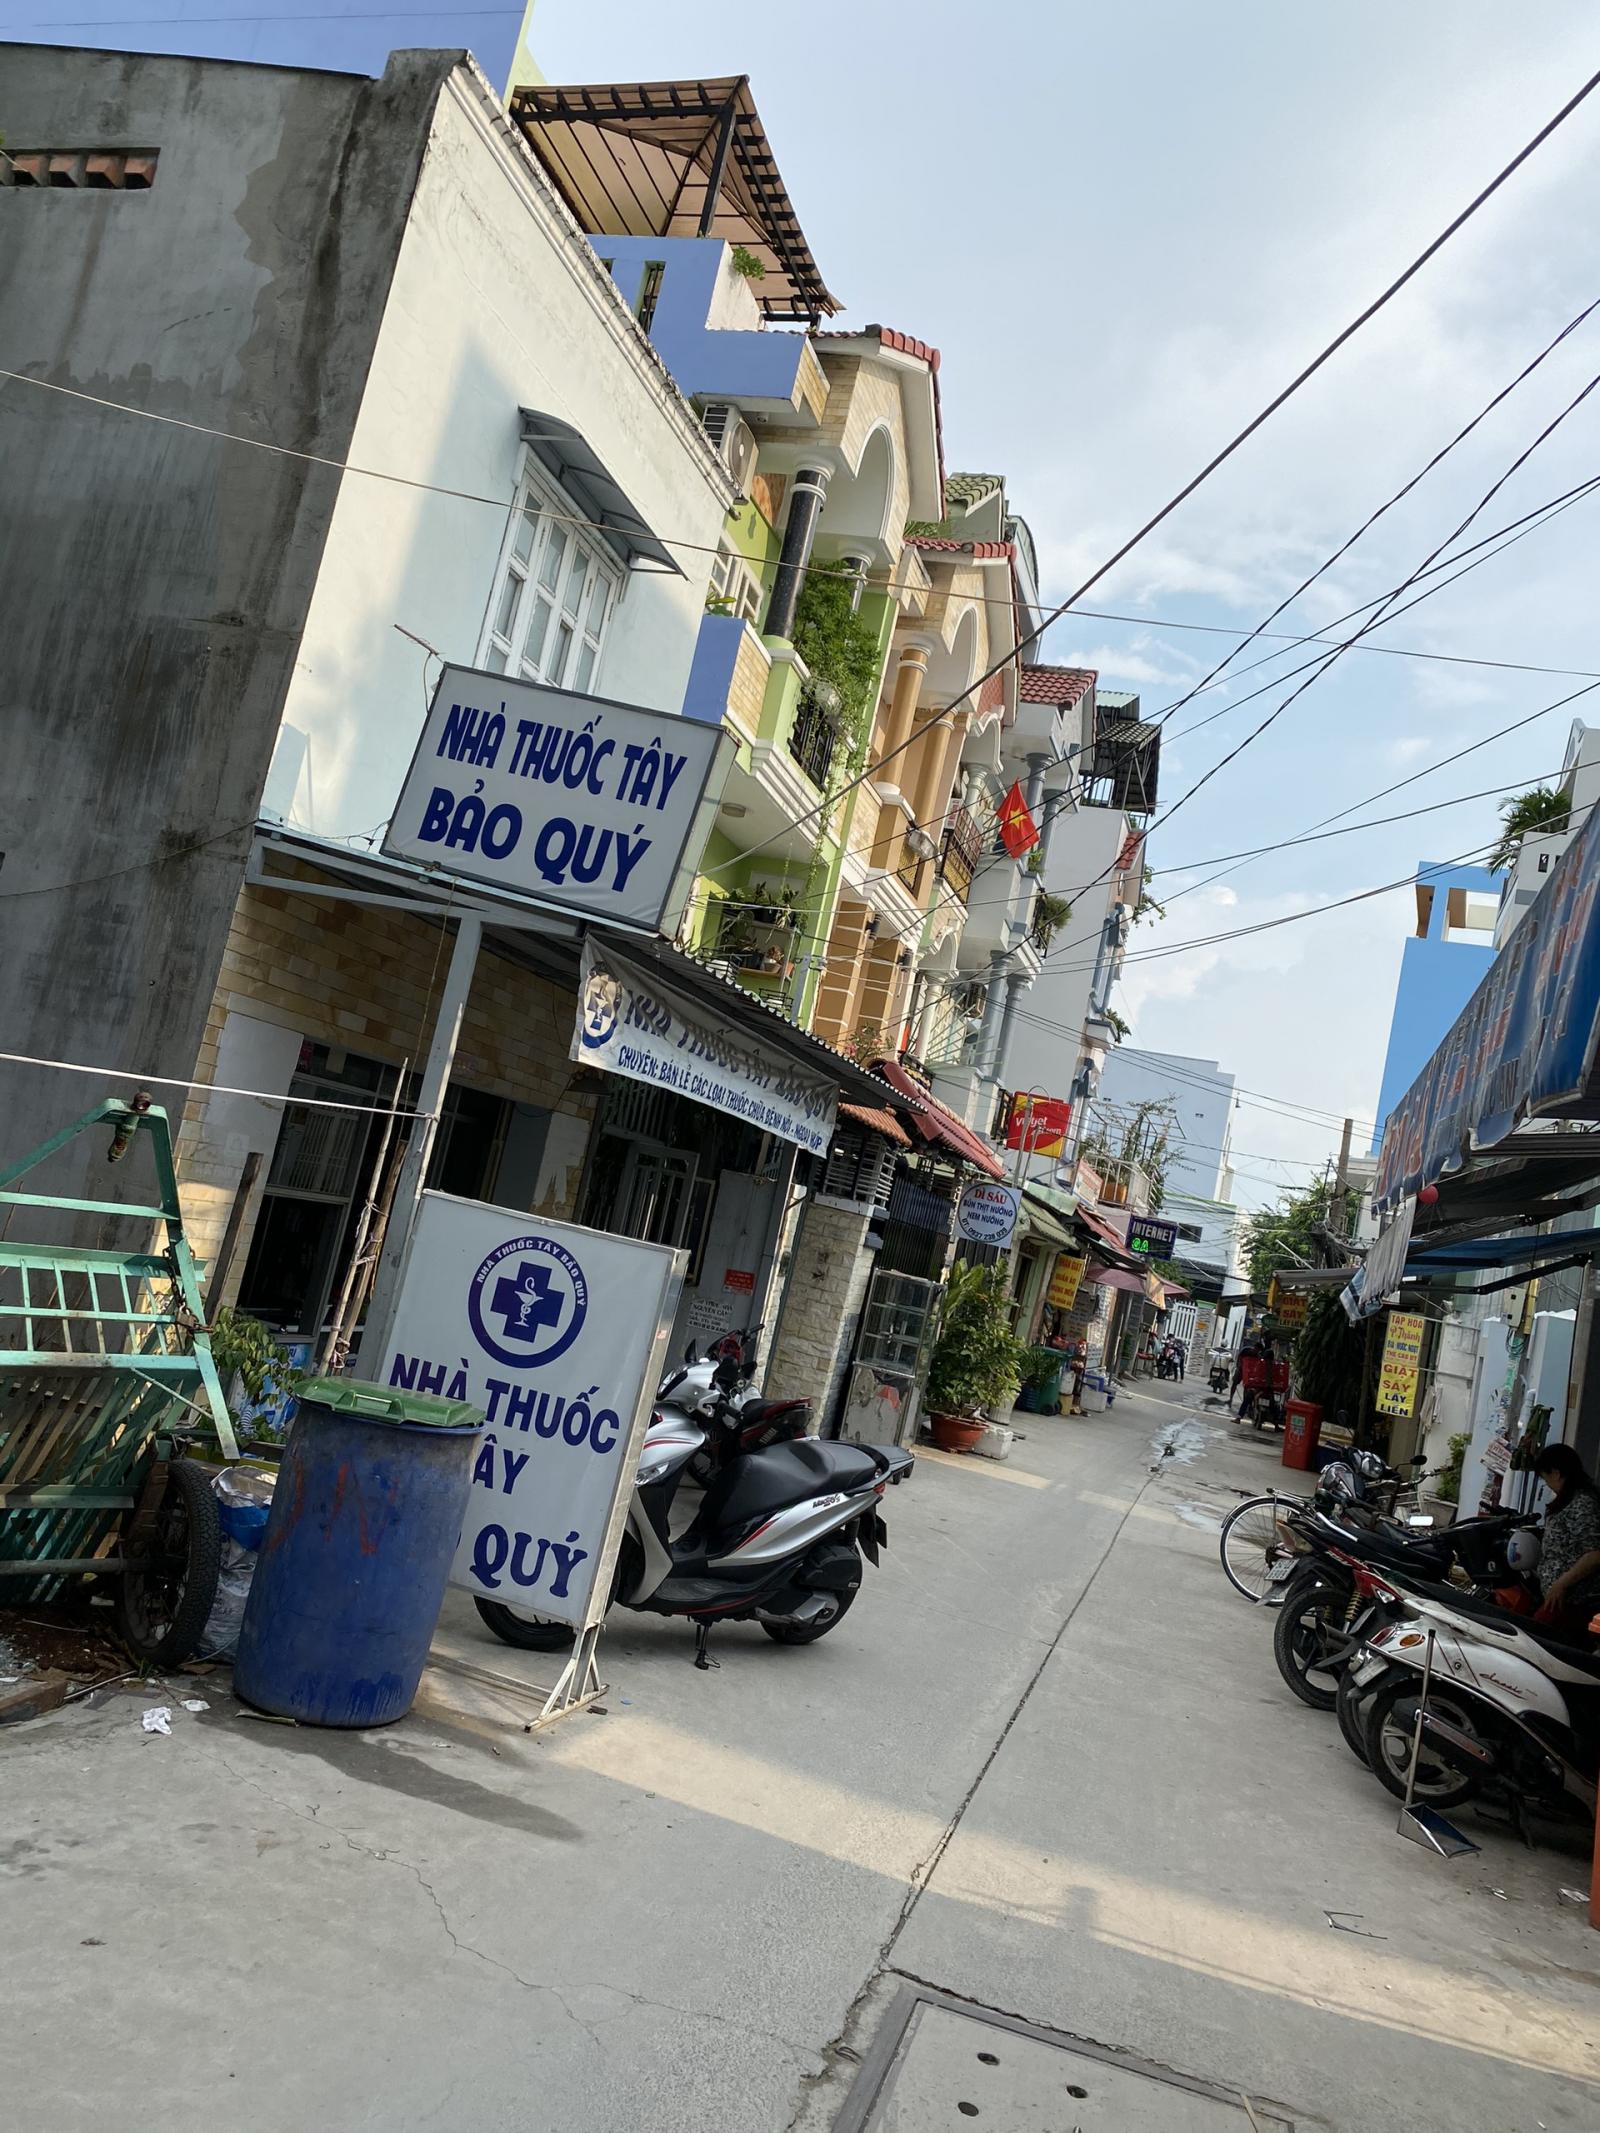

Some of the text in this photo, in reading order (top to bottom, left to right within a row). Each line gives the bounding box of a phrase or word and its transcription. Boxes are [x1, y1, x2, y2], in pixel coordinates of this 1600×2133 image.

[436, 702, 687, 810] NHÀ THUỐC TÂY
[417, 779, 652, 892] BẢO QUÝ
[618, 1045, 658, 1078] CHUYÊN:
[659, 1059, 678, 1085] BÁN
[679, 1064, 691, 1090] LẺ
[691, 1072, 708, 1096] CÁC
[706, 1080, 725, 1106] LOẠI
[724, 1090, 749, 1114] THUỐC
[967, 1211, 980, 1221] NEM
[976, 1202, 990, 1213] THỊT
[987, 1191, 1008, 1204] SÁU
[1131, 1221, 1173, 1243] INTERNET
[477, 1238, 586, 1306] NHÀ THUỐC TÂY BẢO QUÝ
[389, 1354, 620, 1454] NHÀ THUỐC
[472, 1434, 531, 1495] ÂY
[469, 1523, 589, 1598] QUÝ
